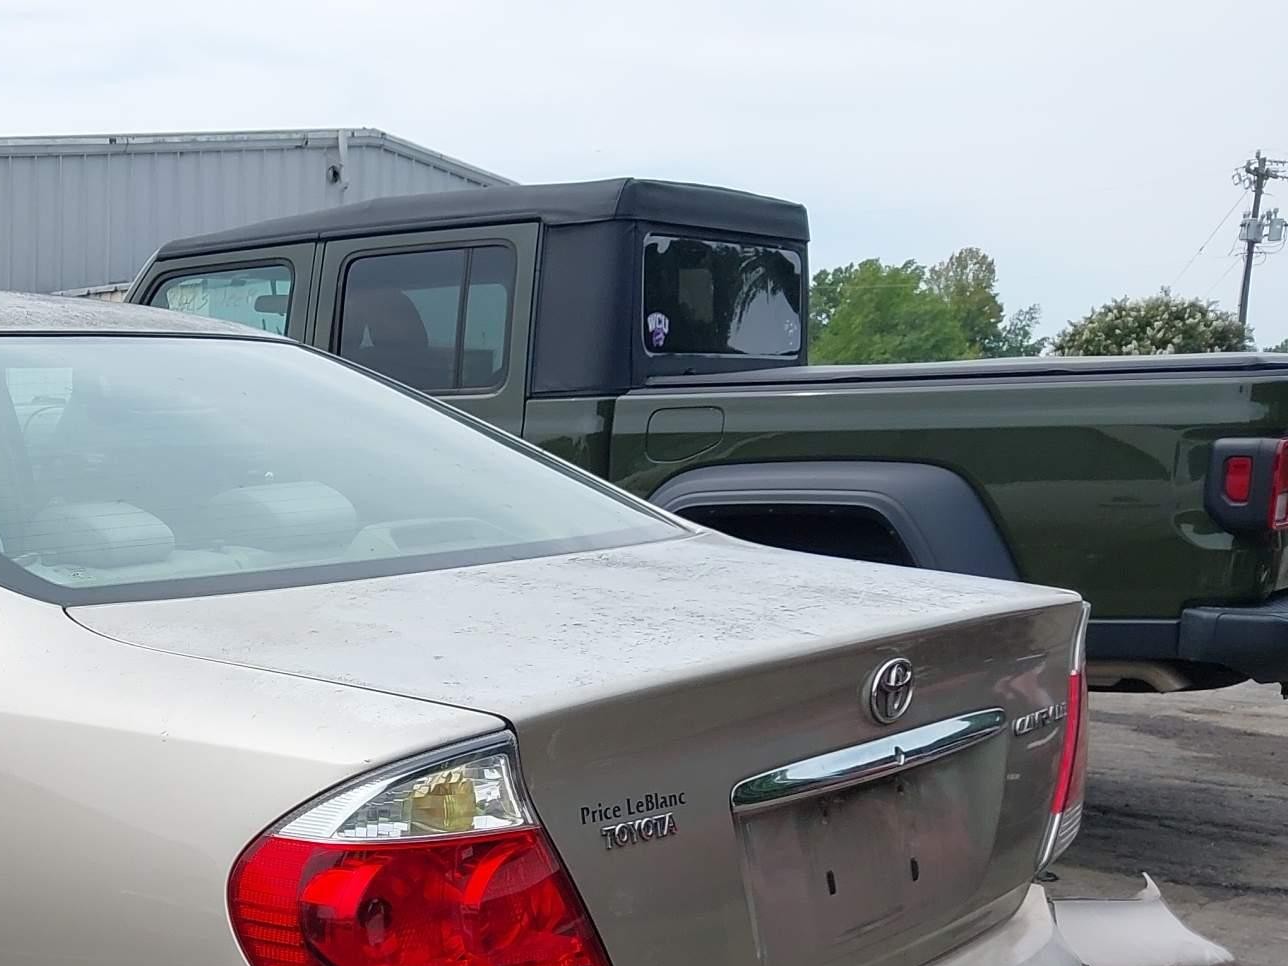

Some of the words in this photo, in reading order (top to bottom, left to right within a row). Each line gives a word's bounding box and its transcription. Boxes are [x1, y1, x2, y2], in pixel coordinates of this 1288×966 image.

[647, 312, 669, 334] WCU
[580, 802, 621, 825] Price
[626, 792, 686, 816] LeBlanc
[600, 811, 678, 850] TOYOTA
